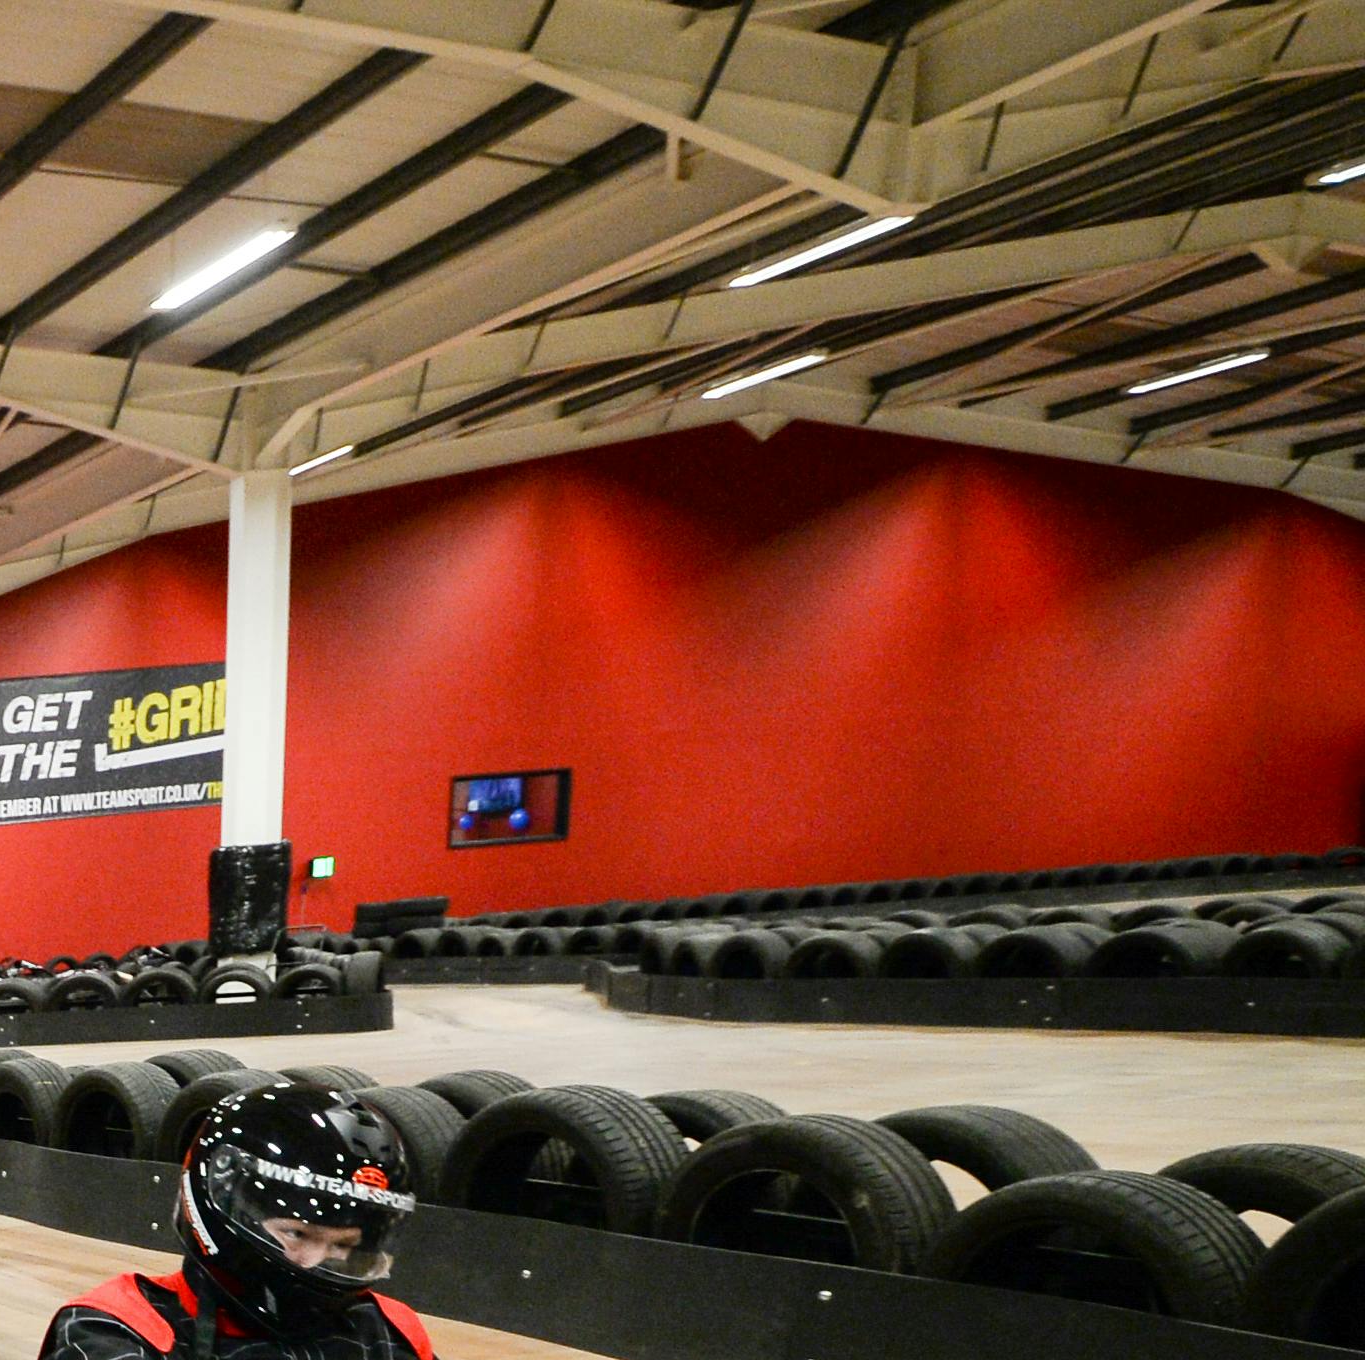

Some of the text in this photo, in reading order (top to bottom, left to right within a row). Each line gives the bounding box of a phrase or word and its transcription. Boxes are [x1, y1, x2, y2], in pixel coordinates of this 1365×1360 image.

[2, 690, 93, 734] GET
[43, 796, 60, 815] AT
[61, 781, 223, 813] WWW.TEAMSPORT.CO.UK/TH
